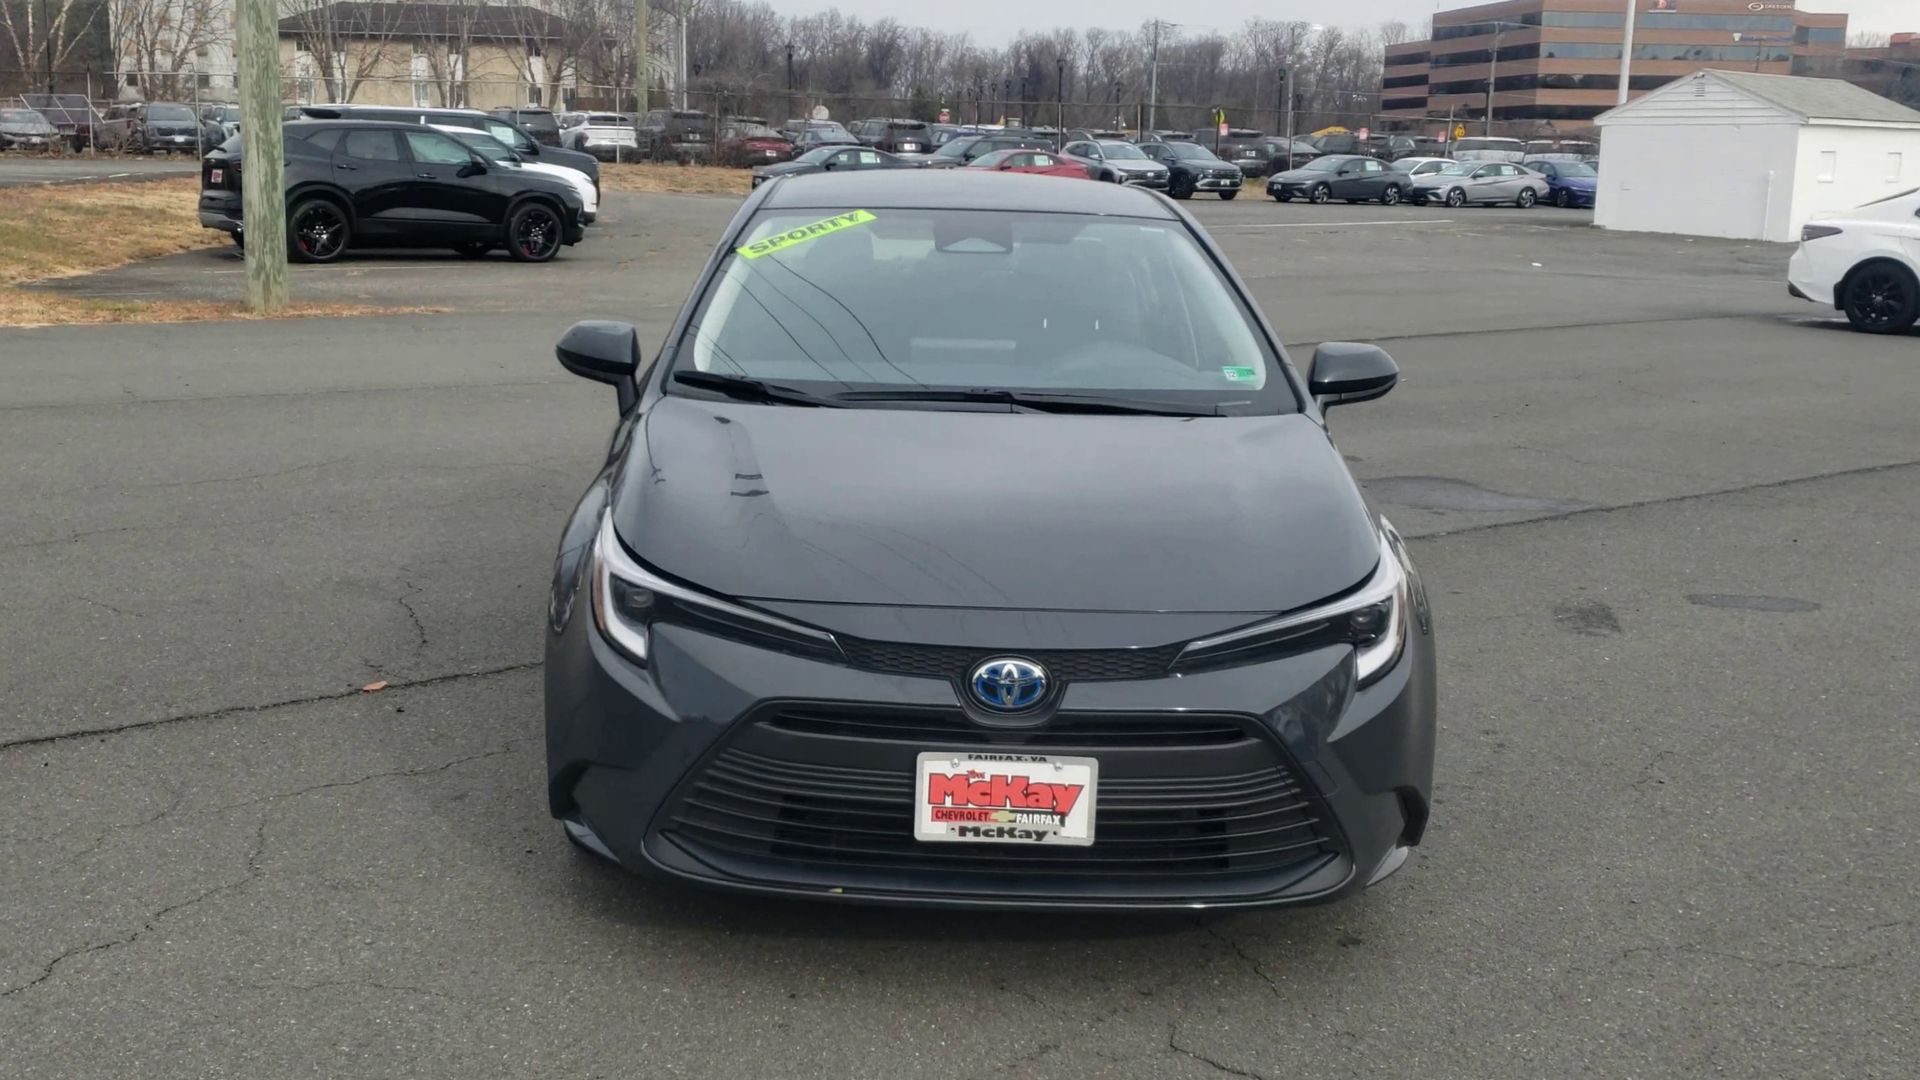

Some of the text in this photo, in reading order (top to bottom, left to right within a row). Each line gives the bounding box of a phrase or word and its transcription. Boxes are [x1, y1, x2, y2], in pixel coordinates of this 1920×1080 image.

[748, 212, 860, 254] SPORTY
[1030, 755, 1047, 763] VA
[928, 773, 1084, 816] McKay
[935, 809, 1061, 826] CHEVROLET FAIRFAX
[958, 825, 1049, 842] McKay
